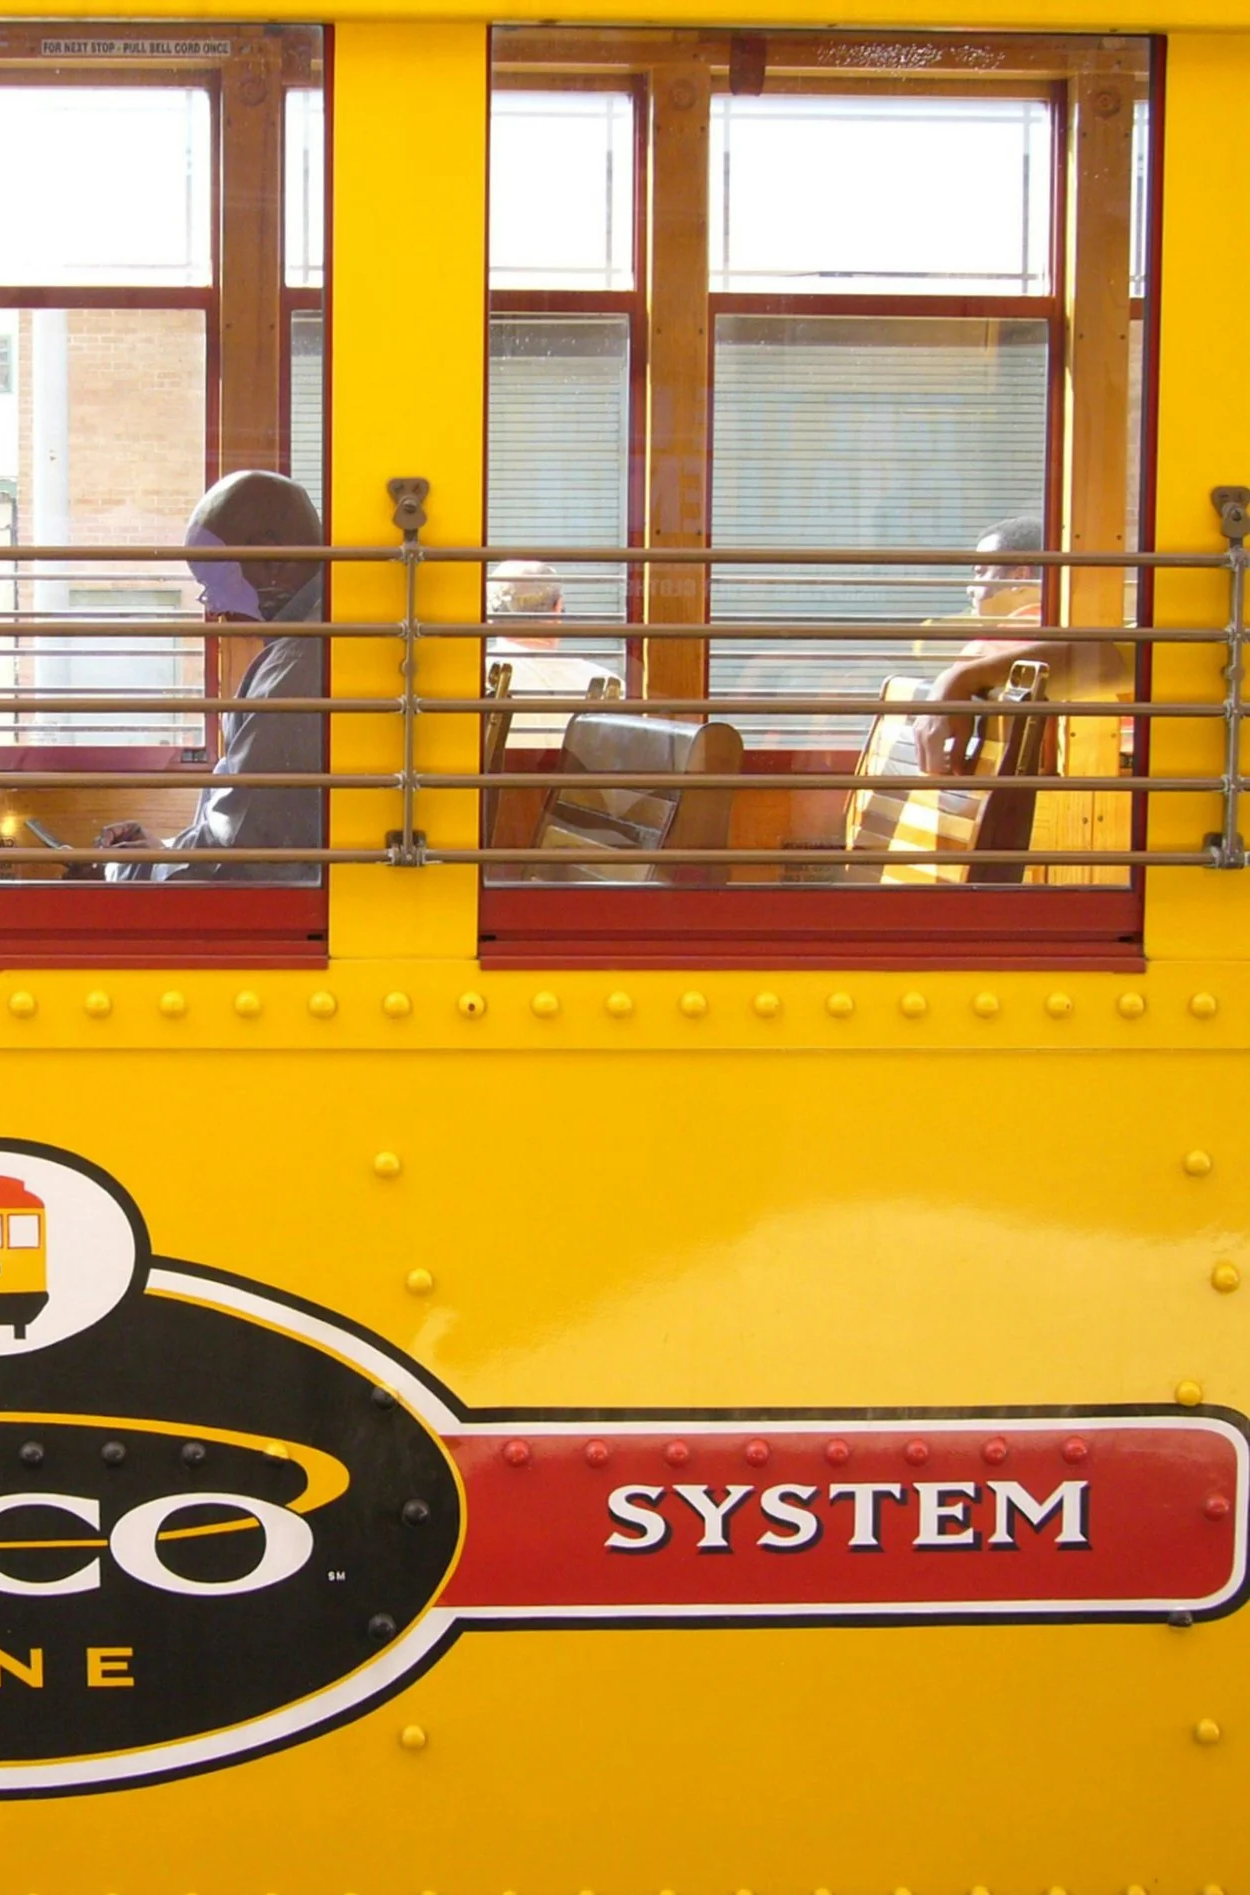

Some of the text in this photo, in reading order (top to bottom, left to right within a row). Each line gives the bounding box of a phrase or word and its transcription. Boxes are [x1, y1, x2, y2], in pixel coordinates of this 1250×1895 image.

[43, 42, 62, 53] FOR
[64, 42, 88, 53] NEXT
[90, 42, 115, 53] STOP
[123, 42, 146, 54] PULL
[150, 42, 172, 54] BELL
[174, 42, 200, 54] CORD
[203, 42, 229, 54] ONCE
[604, 1480, 1090, 1551] SYSTEM
